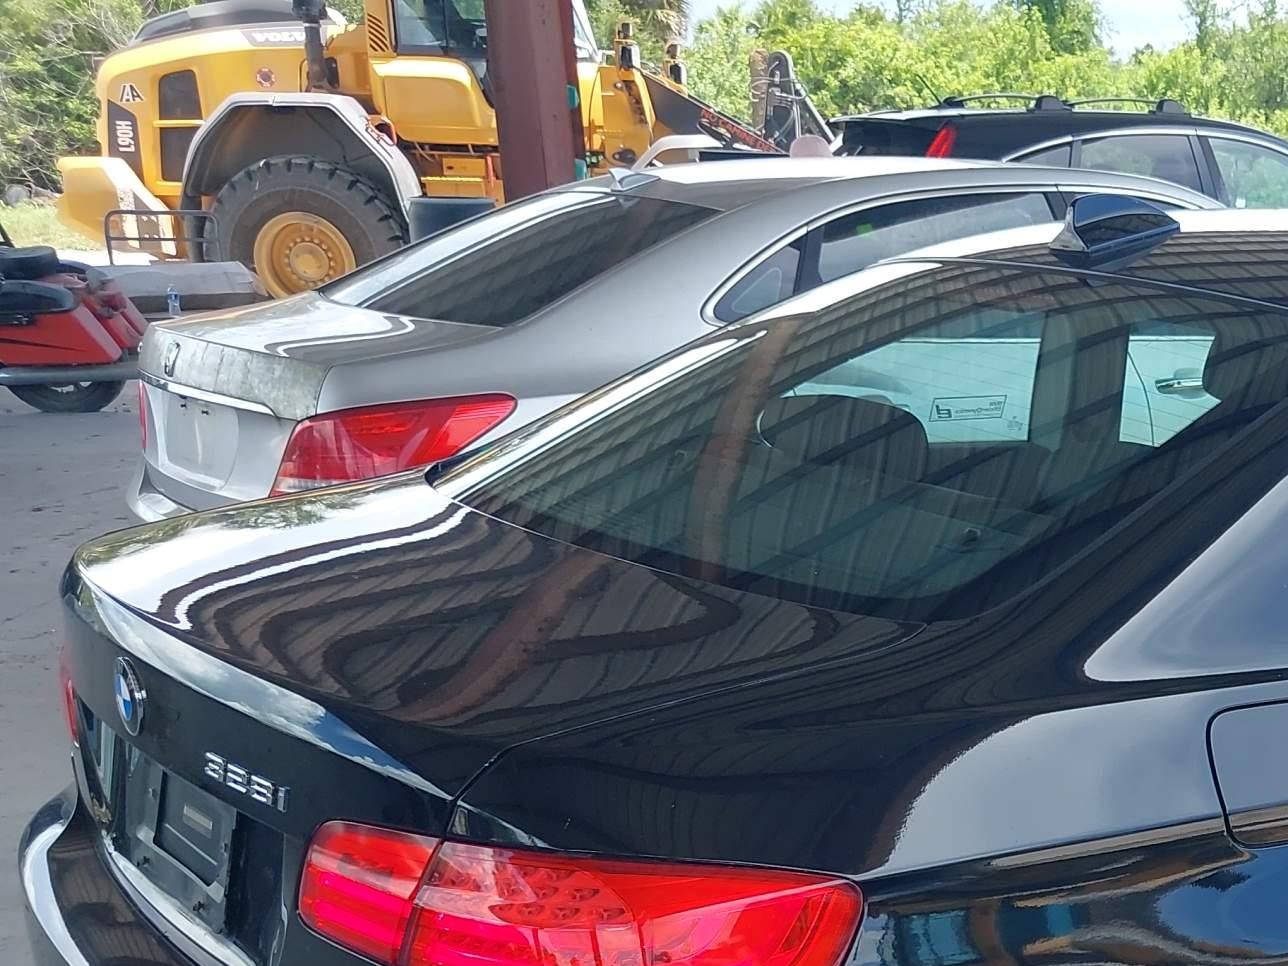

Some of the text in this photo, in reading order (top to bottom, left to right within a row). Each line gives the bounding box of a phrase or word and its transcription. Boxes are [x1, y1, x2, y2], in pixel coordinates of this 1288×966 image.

[253, 31, 306, 42] VOLV
[117, 120, 136, 152] L90H
[204, 751, 290, 812] 328i
